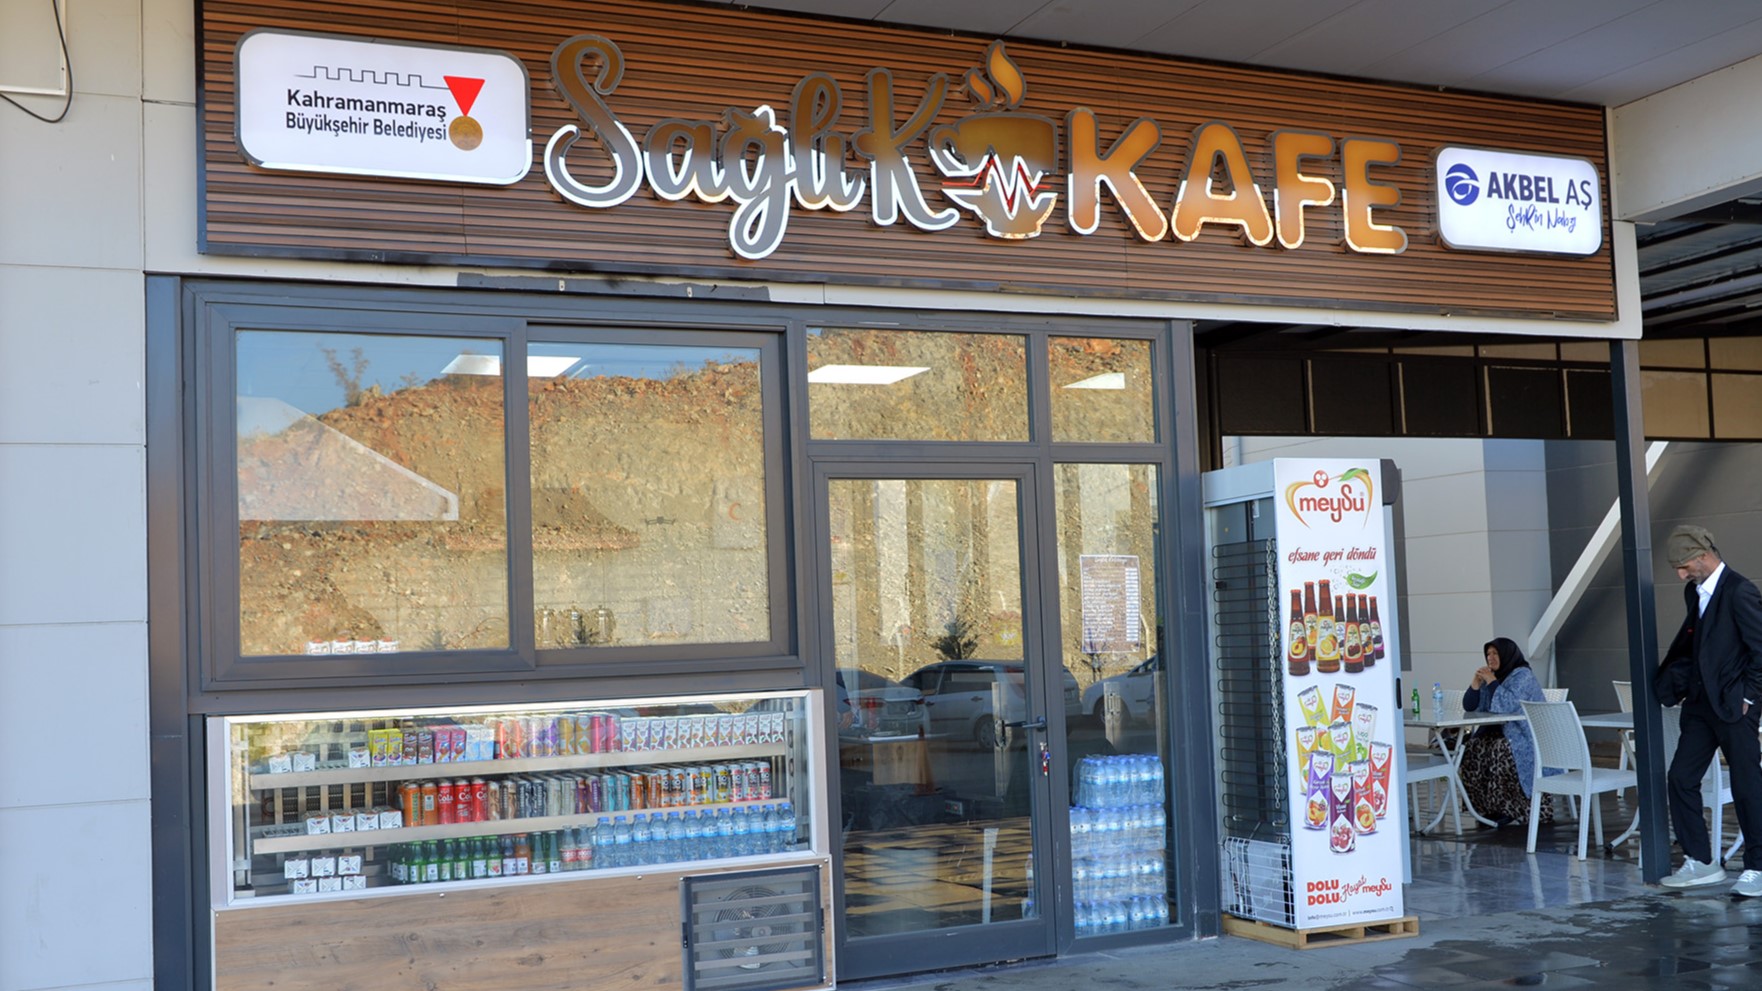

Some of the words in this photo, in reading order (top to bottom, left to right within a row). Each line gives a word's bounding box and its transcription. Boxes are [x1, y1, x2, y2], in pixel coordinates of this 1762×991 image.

[287, 89, 447, 122] Kahramanmaraş
[286, 112, 369, 137] Büyükşehir
[373, 118, 447, 143] Belediyesi
[1065, 105, 1409, 254] KAFE
[1487, 172, 1559, 204] AKBEL
[1565, 178, 1593, 210] AŞ
[1288, 547, 1320, 564] efsane
[1323, 548, 1345, 566] geri
[1346, 546, 1377, 561] döndü
[1307, 880, 1339, 892] DOLU
[1307, 892, 1340, 906] DOLU
